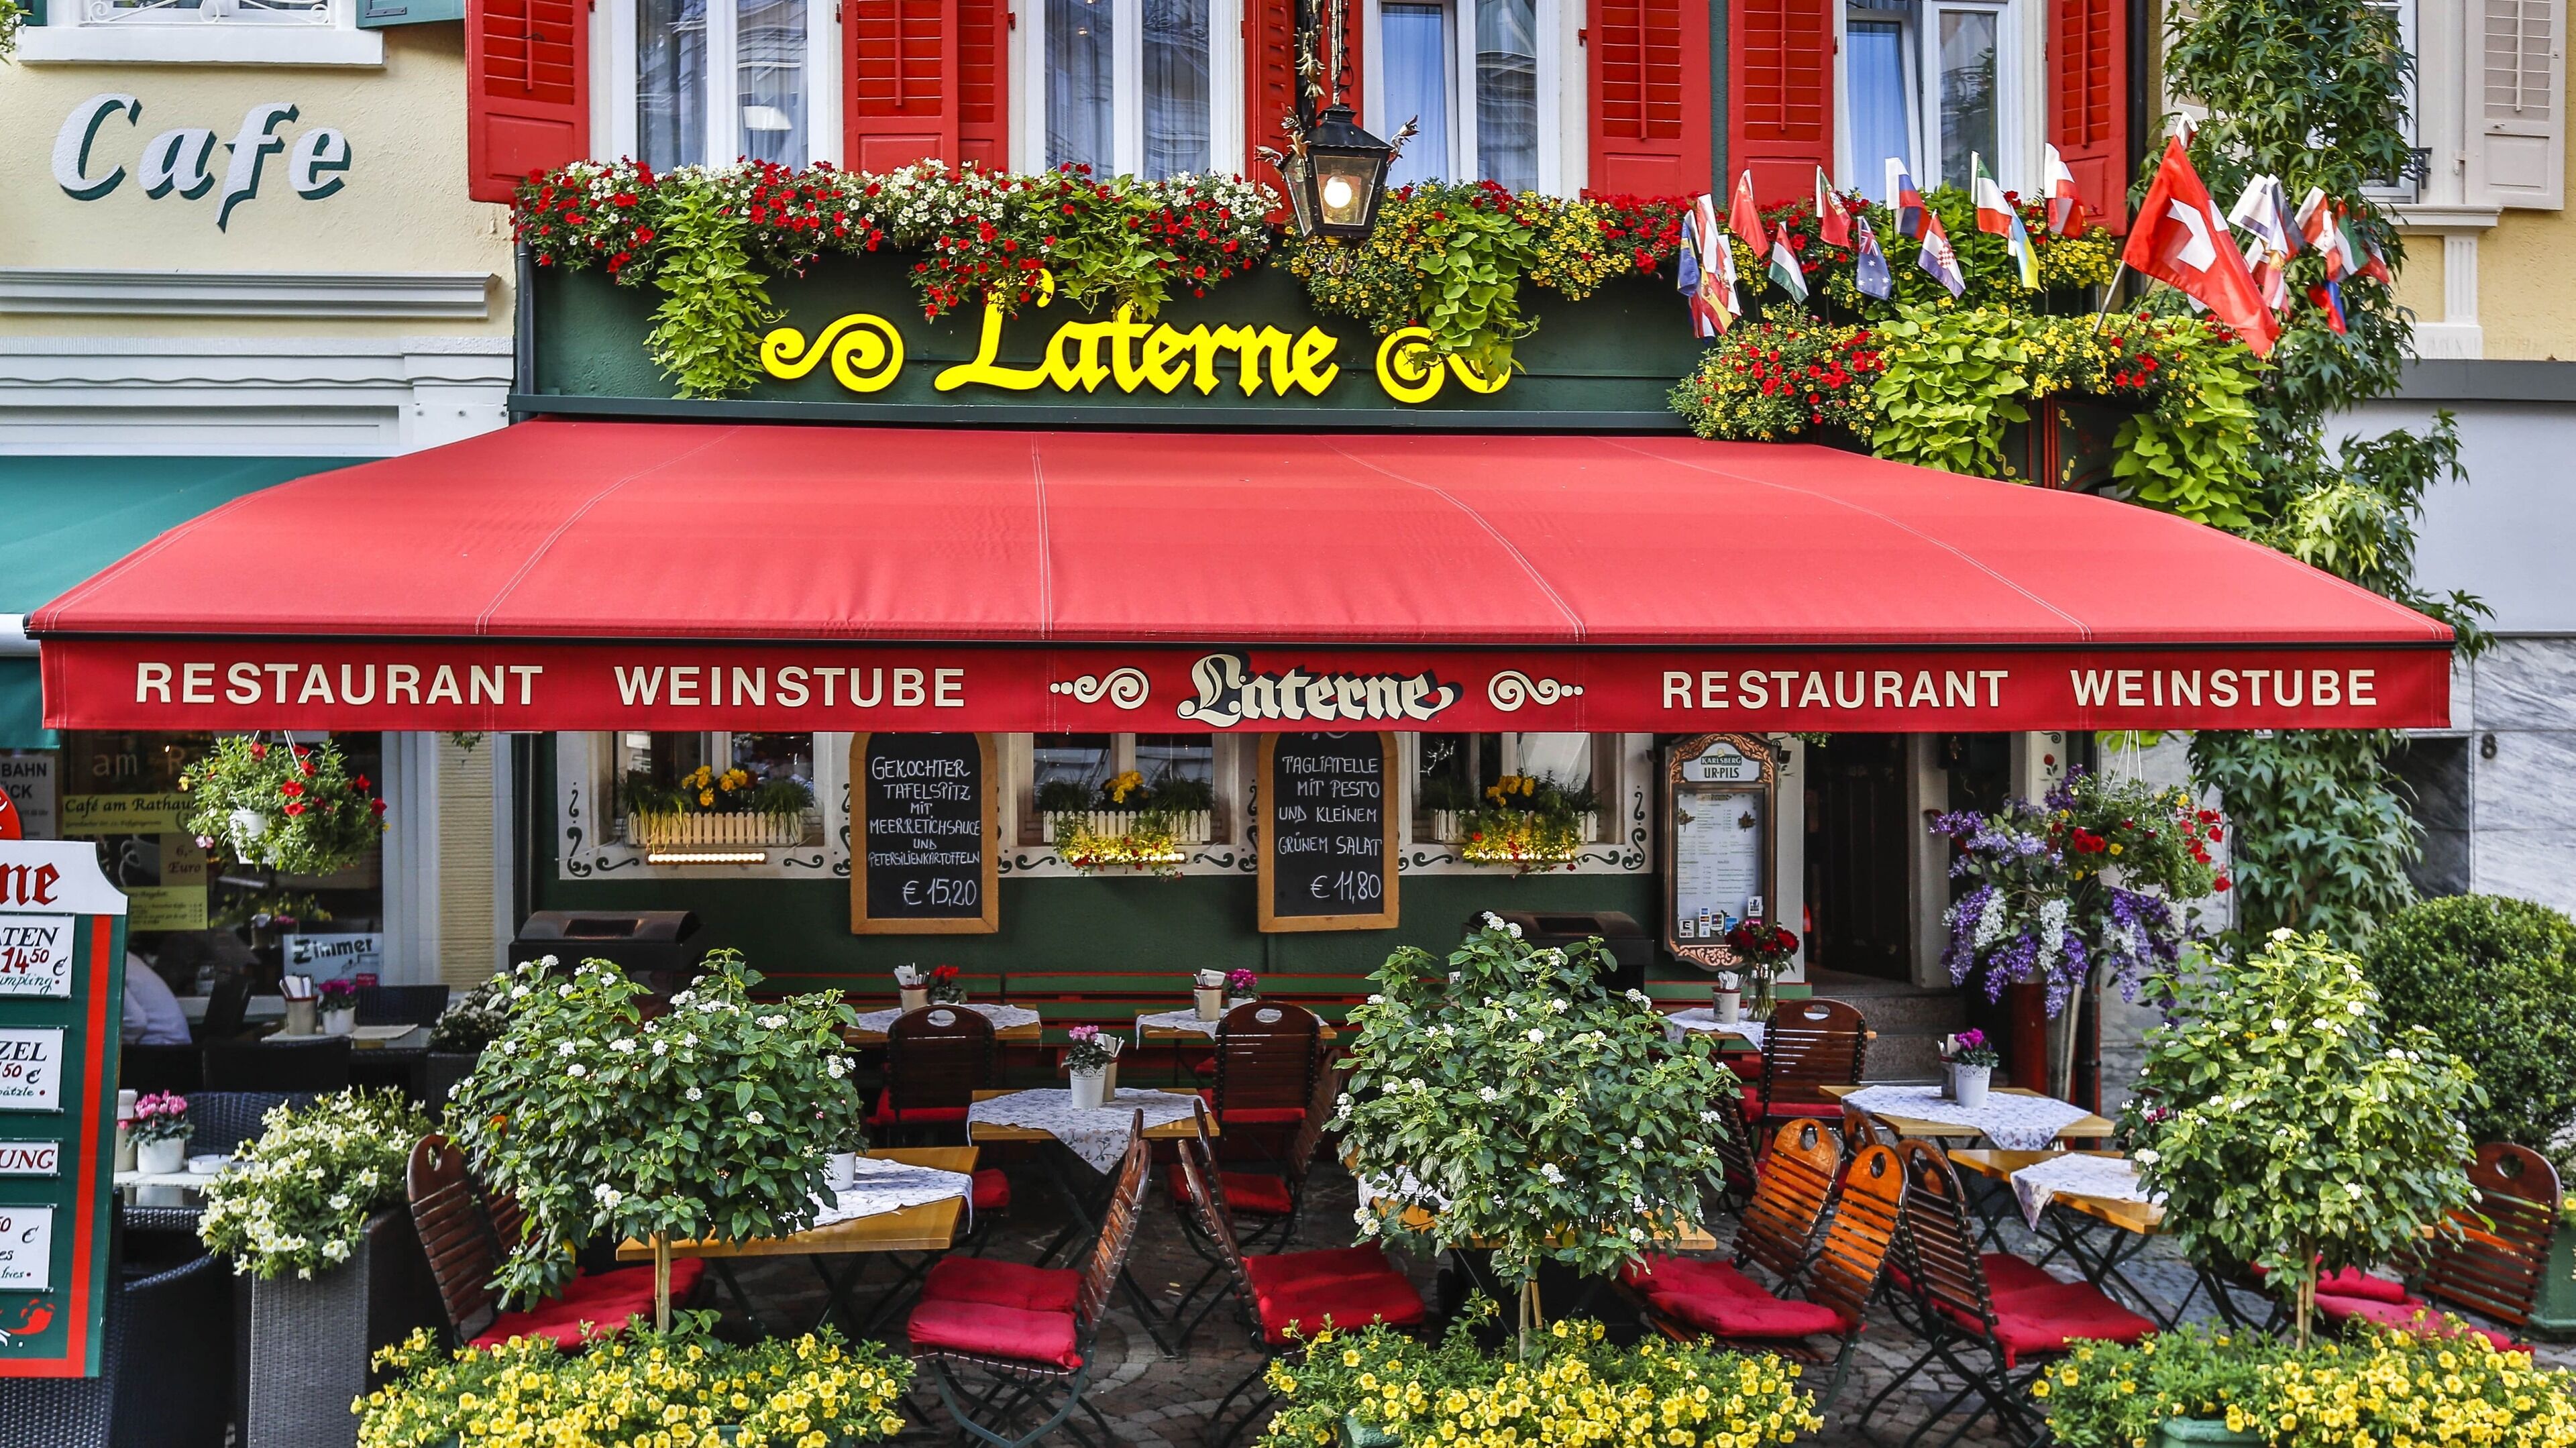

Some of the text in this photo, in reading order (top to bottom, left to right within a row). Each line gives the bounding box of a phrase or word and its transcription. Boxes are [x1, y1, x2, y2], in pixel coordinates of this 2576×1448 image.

[51, 92, 352, 234] Cafe
[933, 267, 1340, 398] Laterne
[136, 661, 965, 708] RESTAURANT WEINSTUBE
[1176, 653, 1457, 728] Laterne
[1662, 668, 2377, 709] RESTAURANT WEINSTUBE
[2481, 734, 2498, 759] 8
[872, 757, 971, 780] GEKOCHTER
[1330, 779, 1380, 798] PESTO
[65, 795, 98, 819] Café
[103, 803, 127, 812] am
[1279, 805, 1307, 824] UND
[913, 838, 937, 850] UND
[1278, 832, 1383, 856] GRÜNEM SALAT
[168, 861, 201, 875] Euro
[902, 877, 977, 907] € 15,20
[1310, 871, 1382, 905] € 11,80
[293, 938, 373, 964] Zimmer
